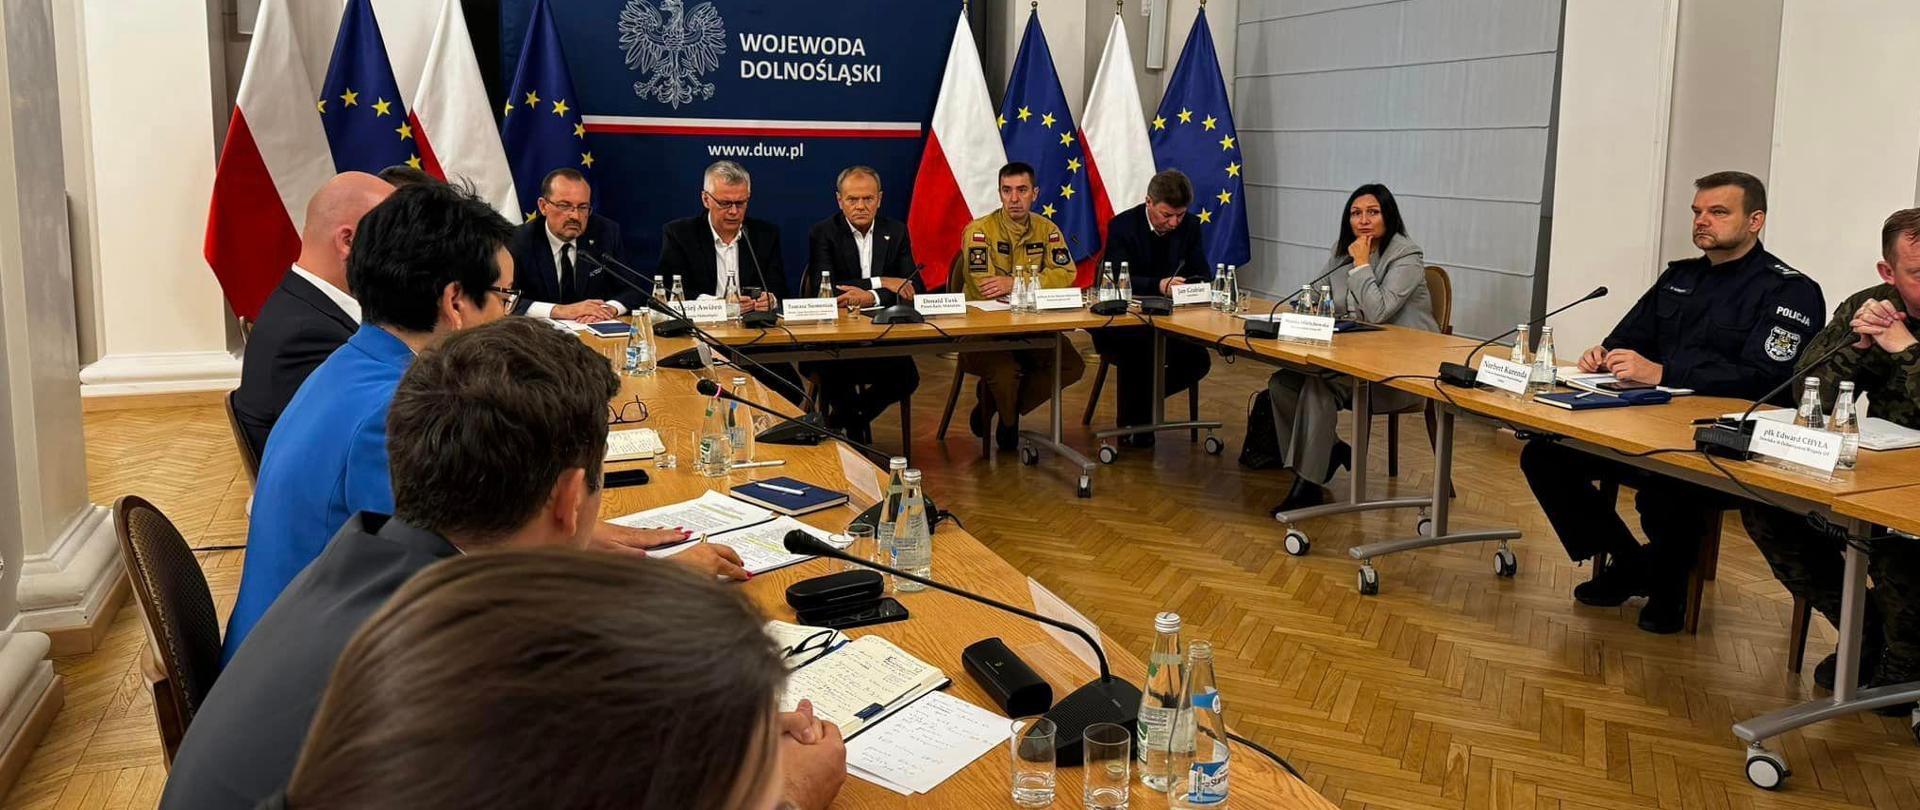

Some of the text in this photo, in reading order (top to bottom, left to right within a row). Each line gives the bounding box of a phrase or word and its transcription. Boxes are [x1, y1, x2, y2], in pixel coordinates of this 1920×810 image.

[739, 32, 866, 57] WOJEWODA
[740, 58, 881, 86] DOLNOŚLĄSKI
[707, 142, 804, 160] www.duw.pl
[1775, 306, 1810, 327] POLICJA
[1775, 431, 1802, 443] Edward
